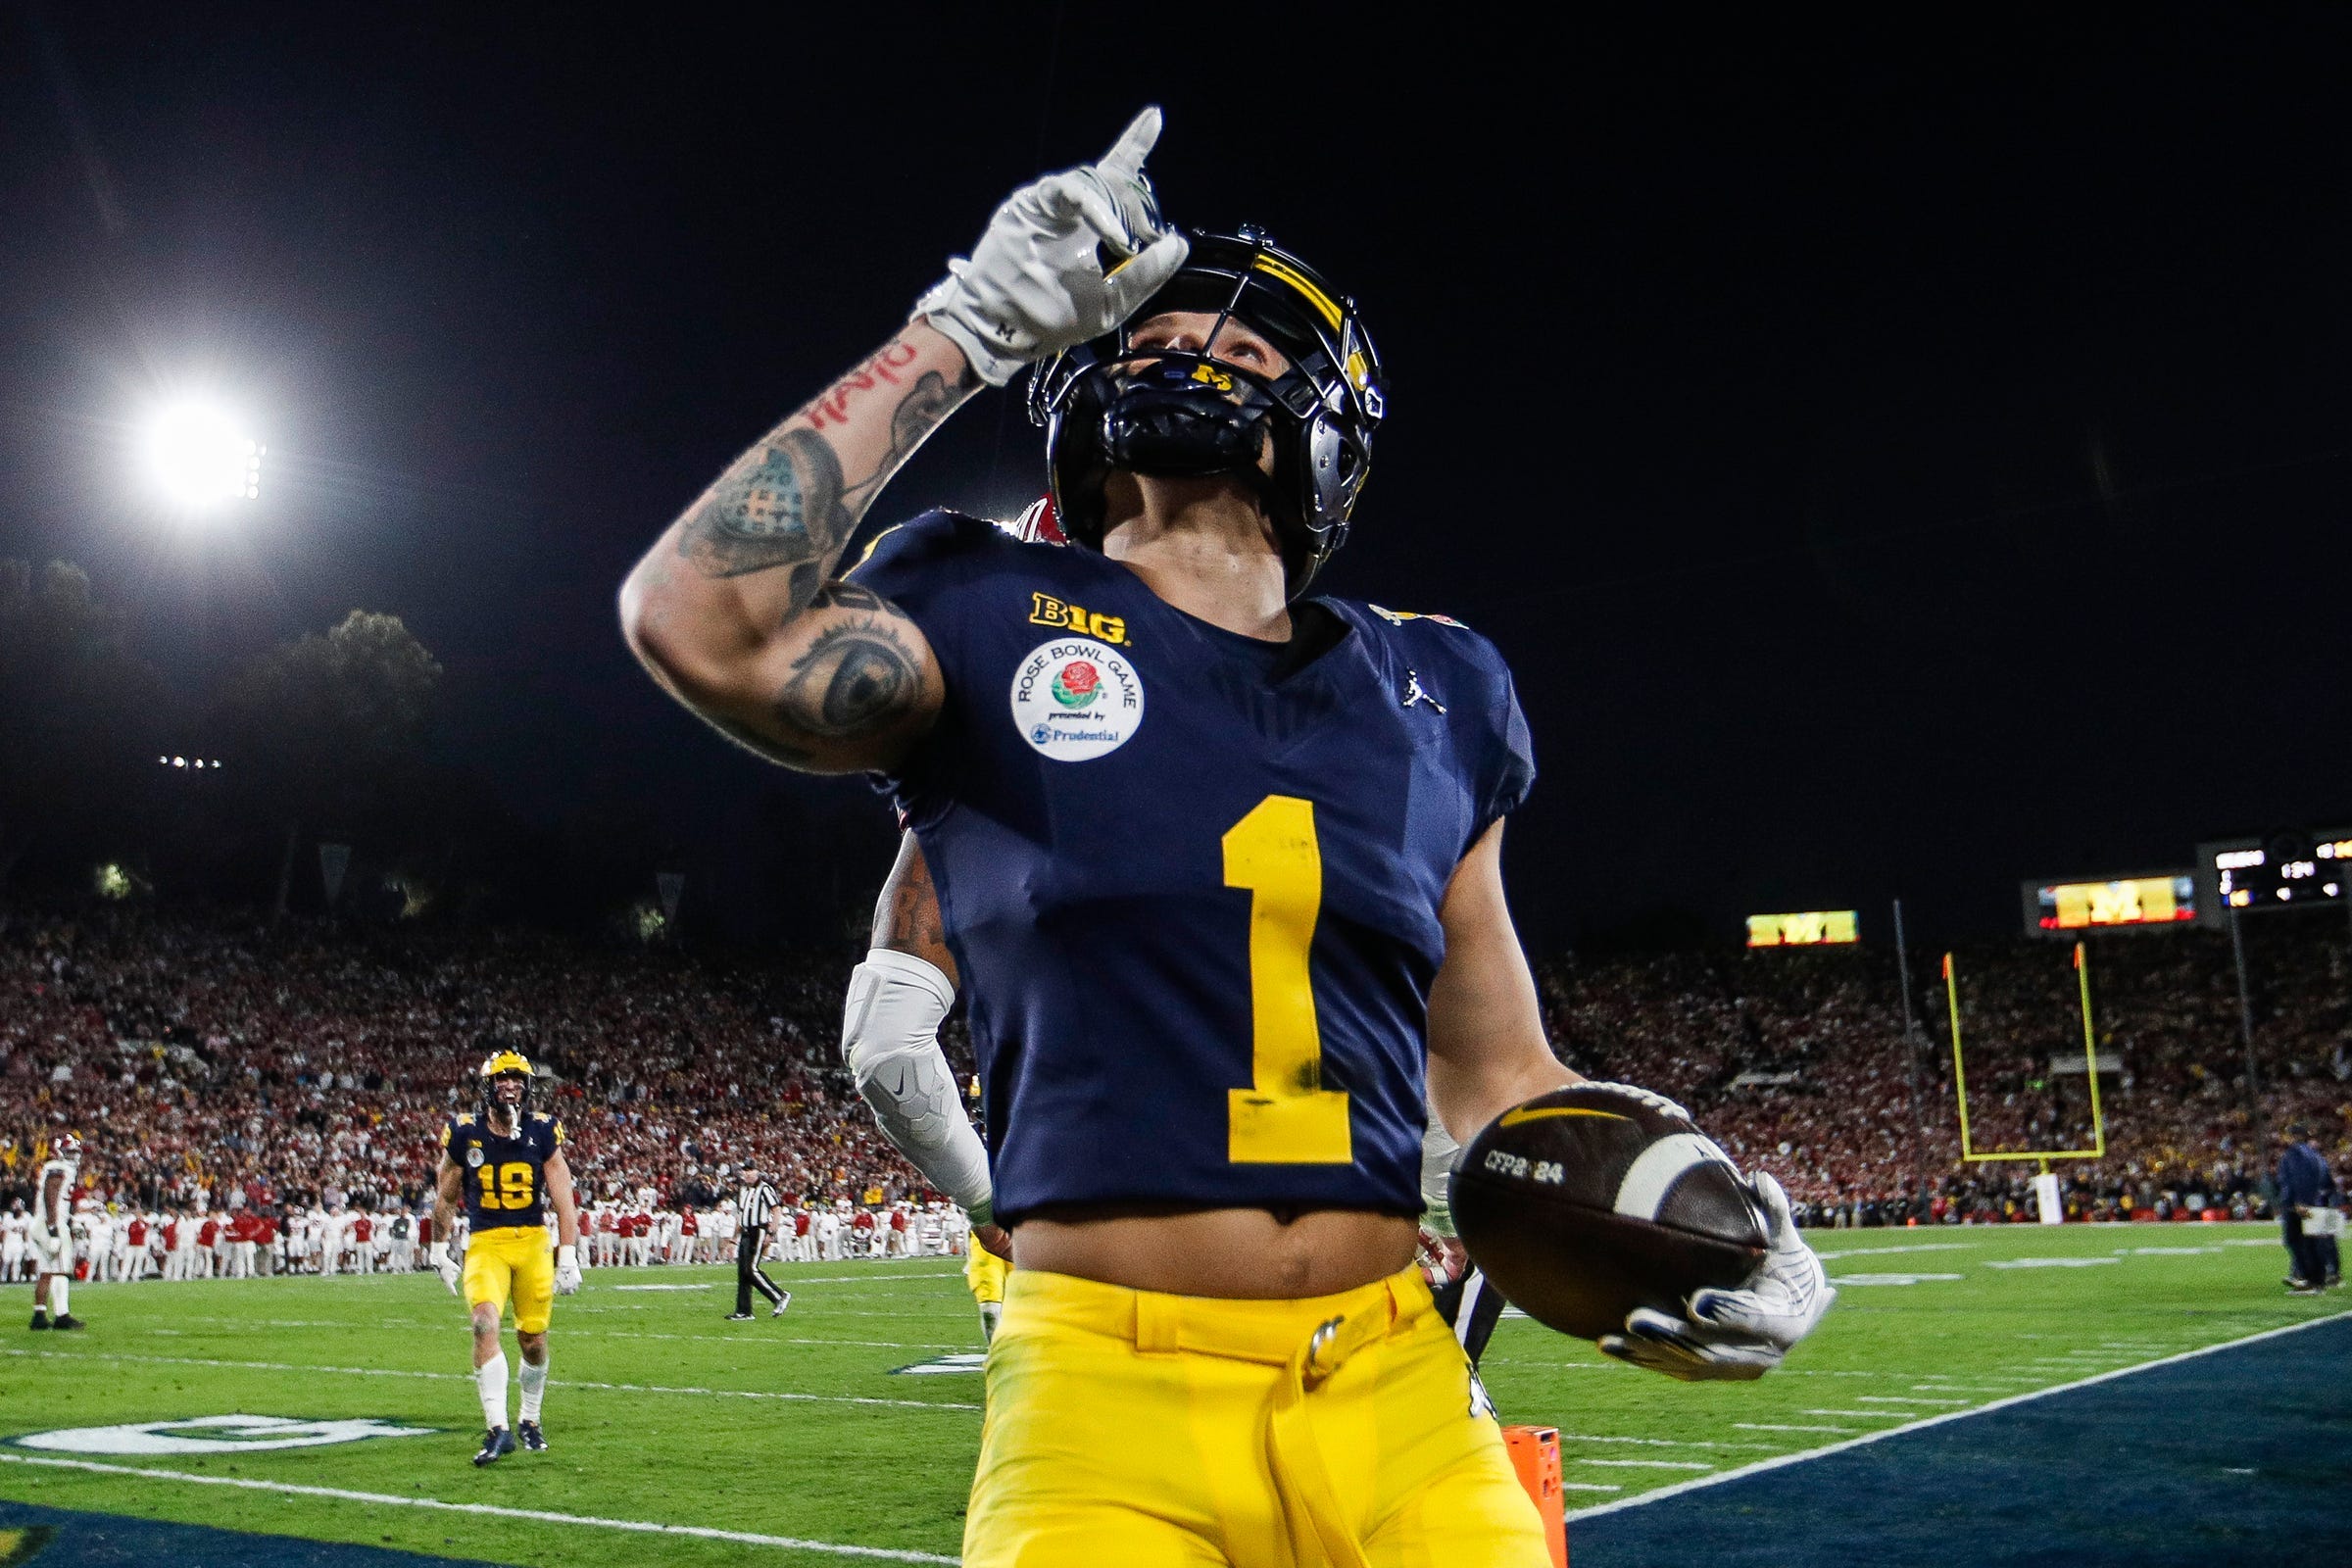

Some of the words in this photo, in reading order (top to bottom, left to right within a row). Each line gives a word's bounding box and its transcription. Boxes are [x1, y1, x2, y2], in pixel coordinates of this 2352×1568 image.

[1018, 655, 1049, 703] ROSE
[1051, 644, 1103, 662] BOWL
[1107, 660, 1137, 710] GAME
[1049, 711, 1091, 720] presented
[1054, 729, 1118, 742] Prudential
[1222, 795, 1353, 1163] 1
